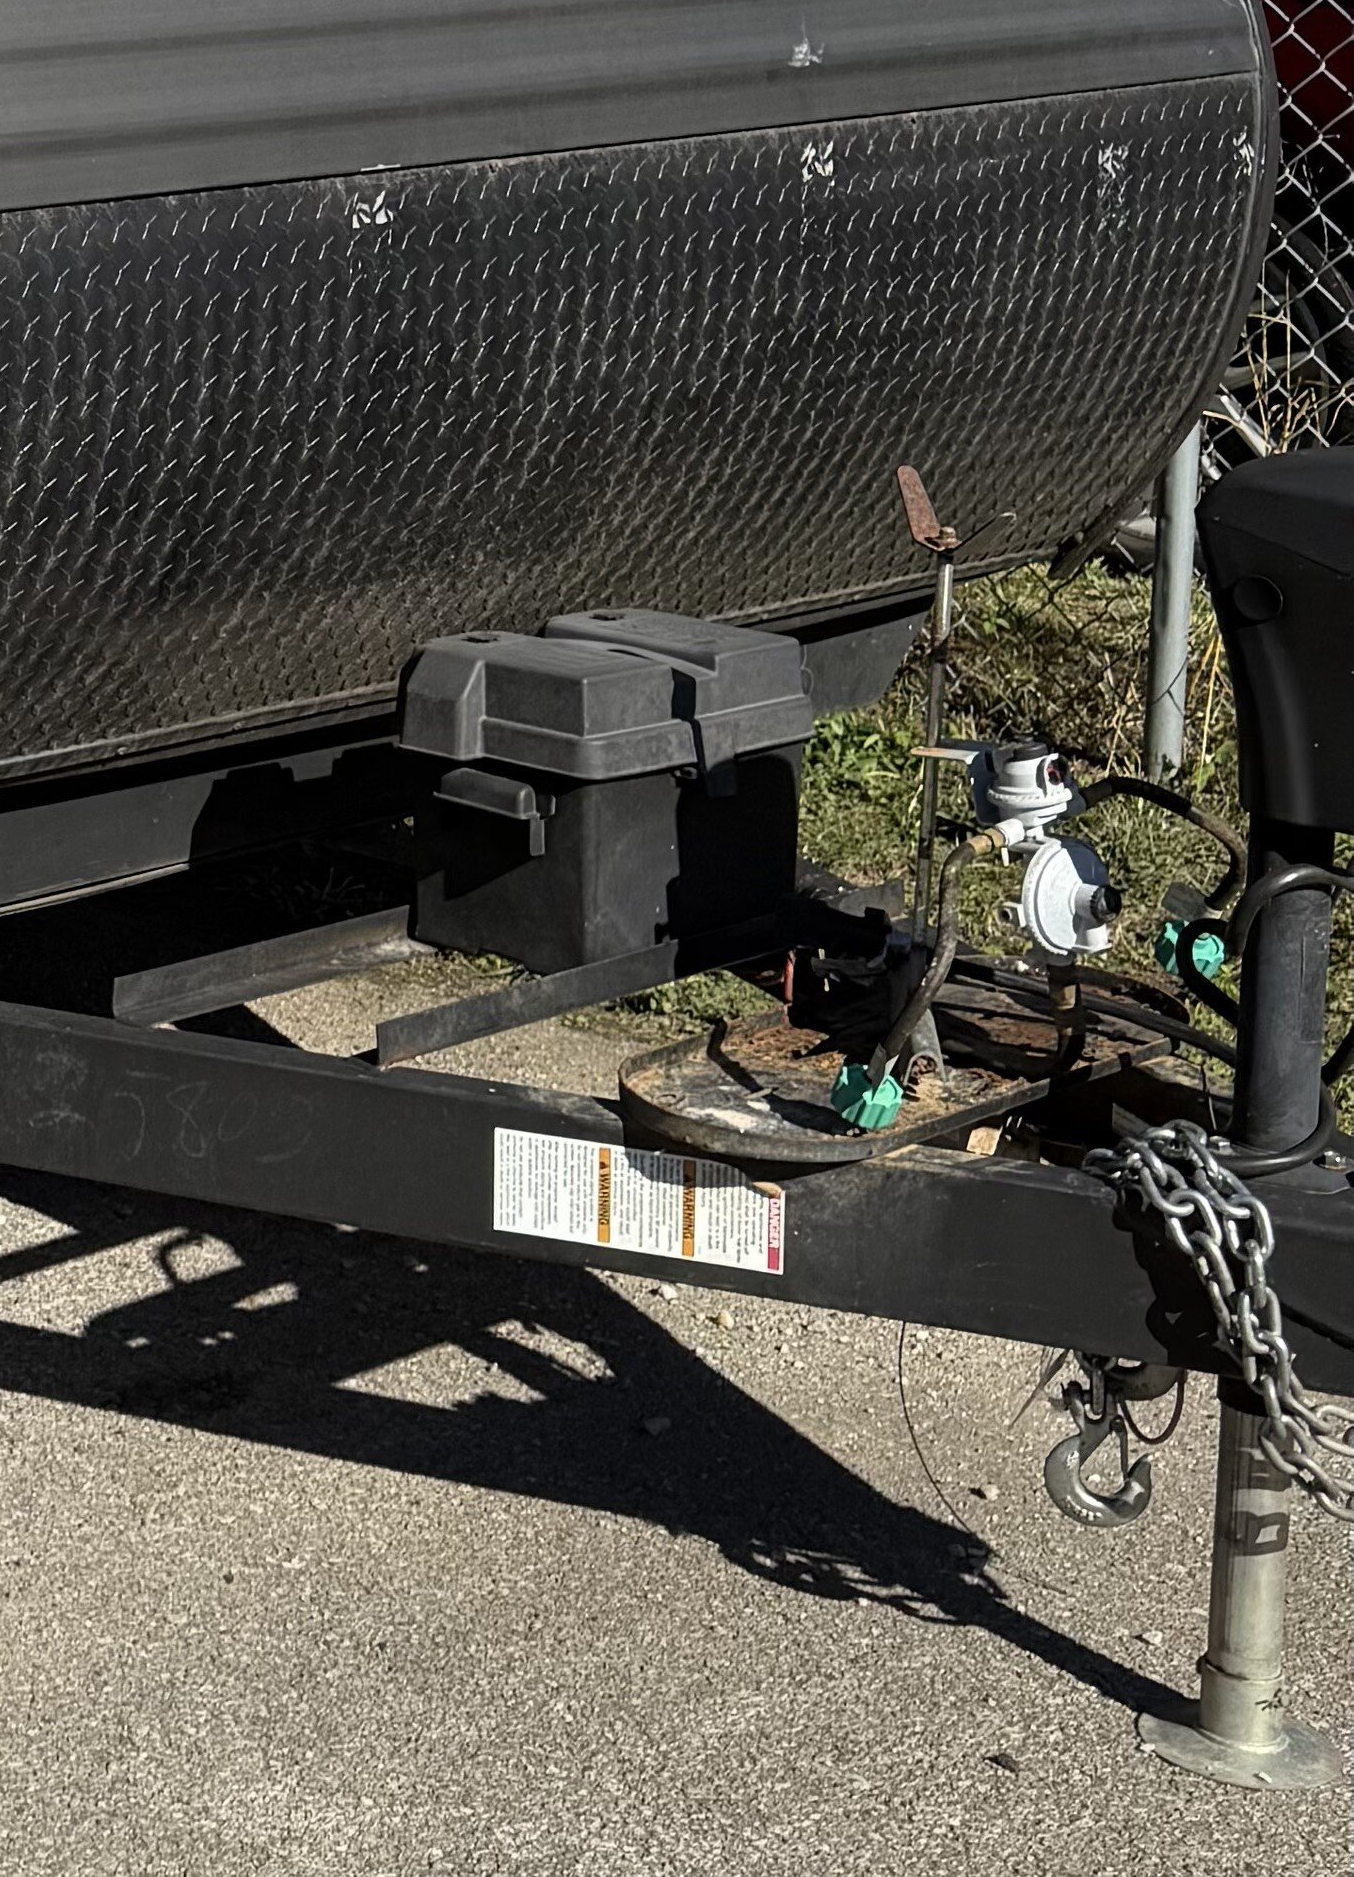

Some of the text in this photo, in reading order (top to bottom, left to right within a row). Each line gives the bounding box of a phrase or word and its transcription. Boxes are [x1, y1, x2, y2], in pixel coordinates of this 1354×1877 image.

[598, 1173, 610, 1226] WARNING
[683, 1185, 694, 1240] WARNING
[769, 1198, 780, 1249] DANGER
